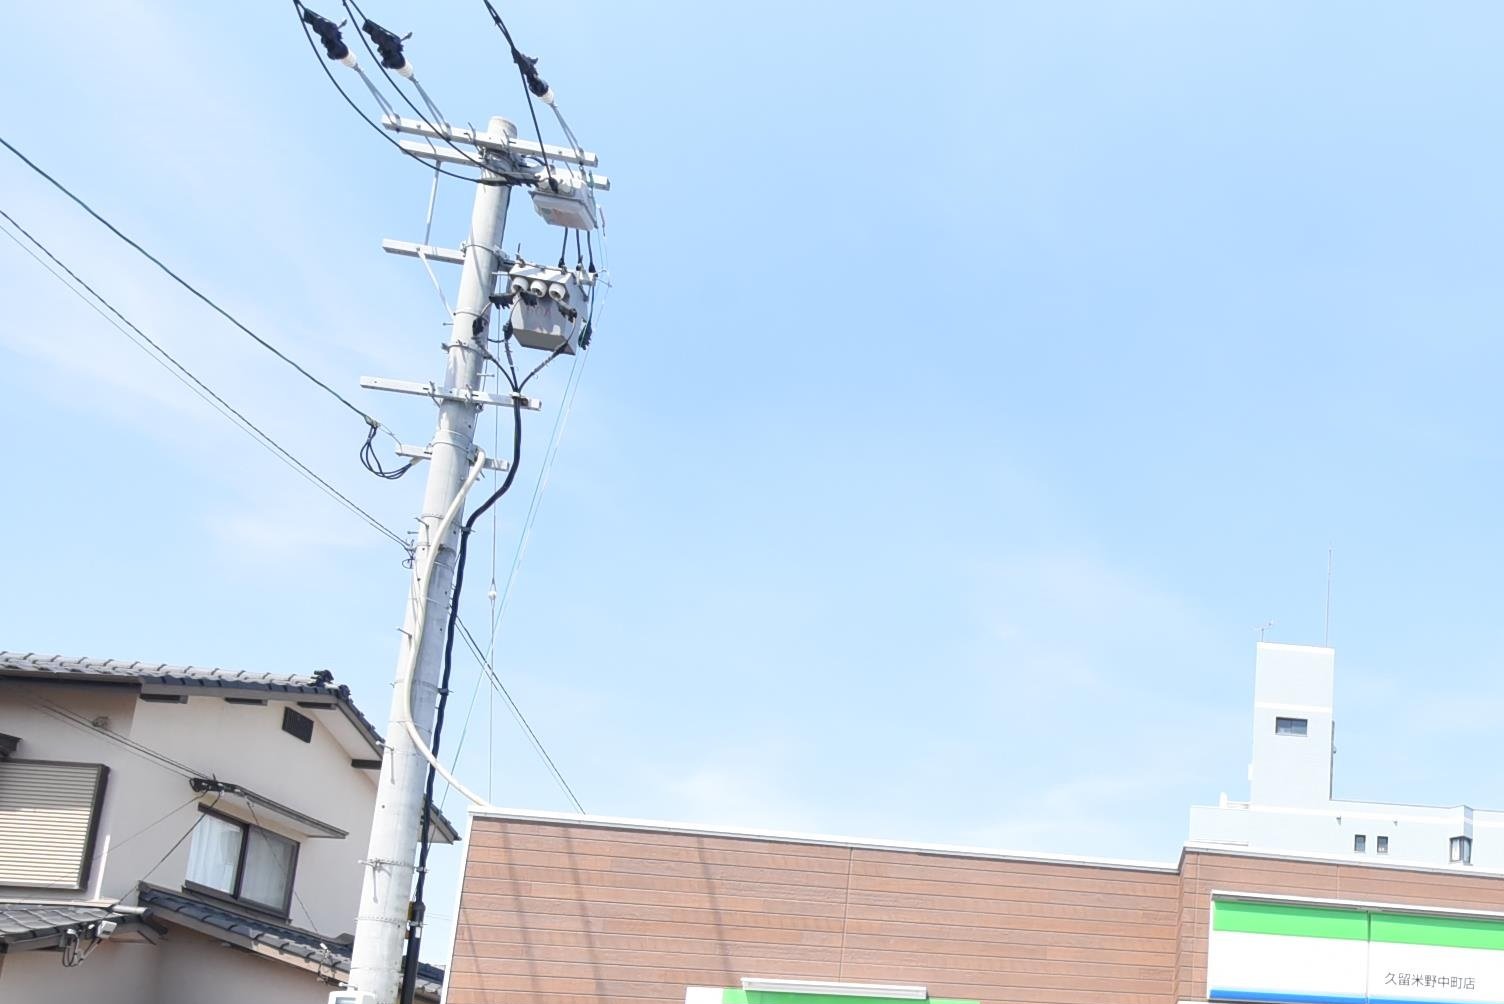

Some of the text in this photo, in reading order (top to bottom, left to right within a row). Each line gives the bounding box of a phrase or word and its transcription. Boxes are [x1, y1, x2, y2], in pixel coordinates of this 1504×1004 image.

[1384, 971, 1476, 990] 久留米野中町店
